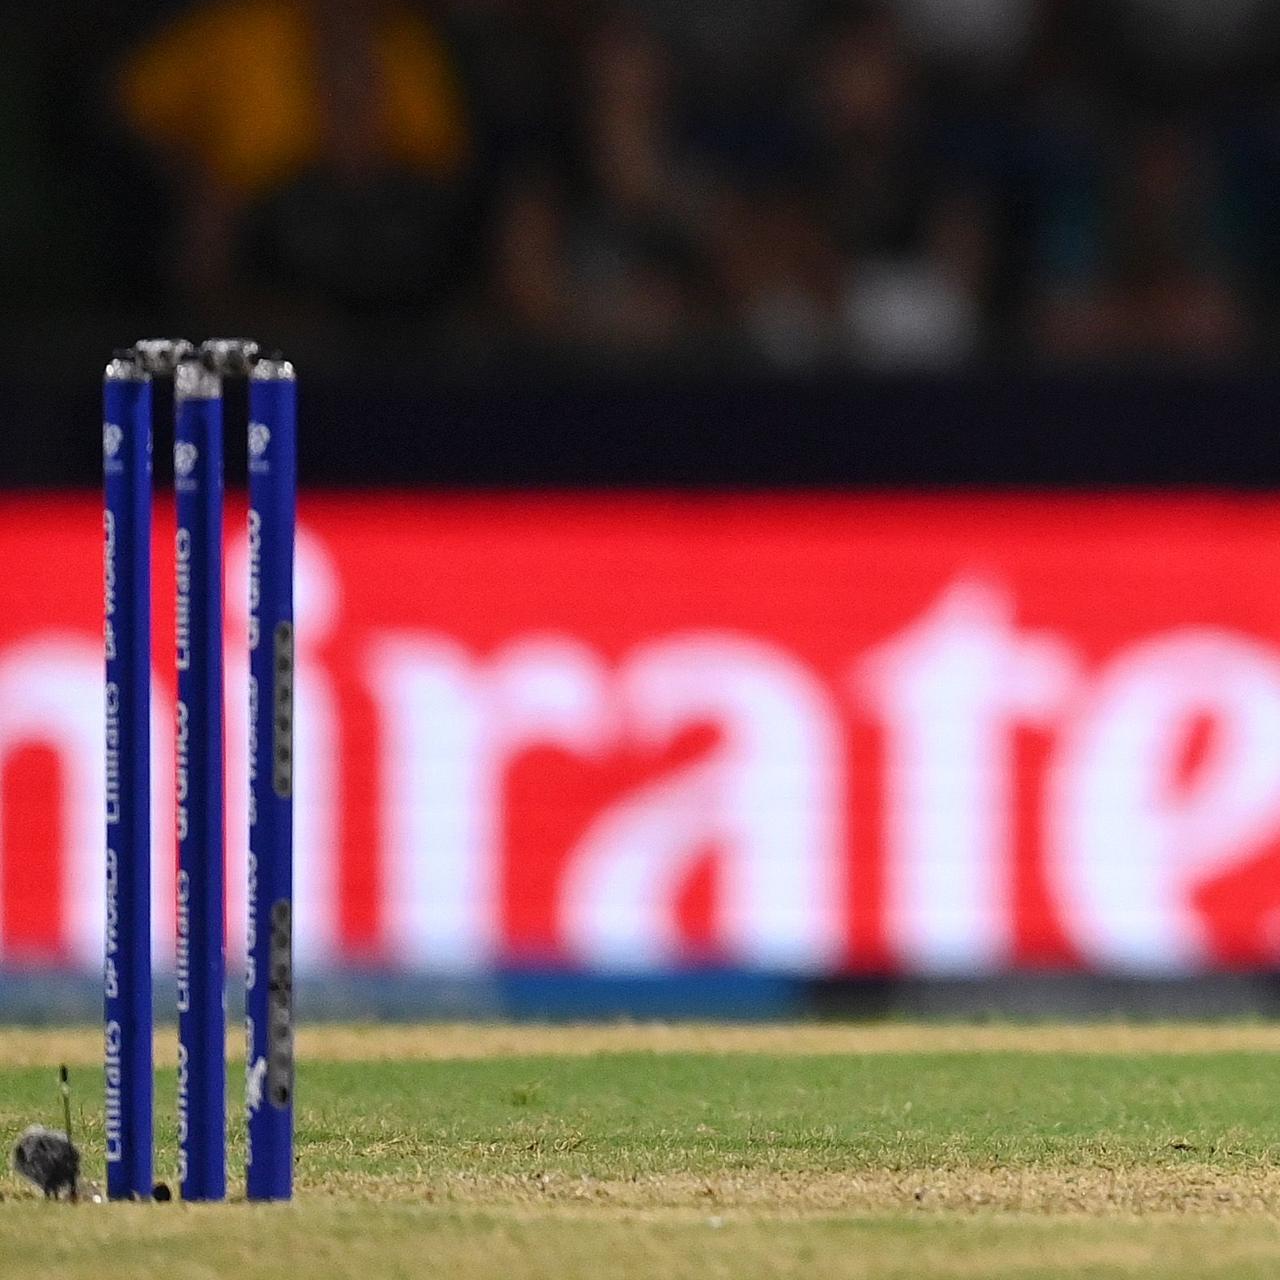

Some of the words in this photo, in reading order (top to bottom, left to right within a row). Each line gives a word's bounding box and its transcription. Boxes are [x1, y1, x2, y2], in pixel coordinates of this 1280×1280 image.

[174, 527, 191, 671] Emirates
[103, 681, 121, 825] Emirates
[103, 1019, 123, 1163] Emirates
